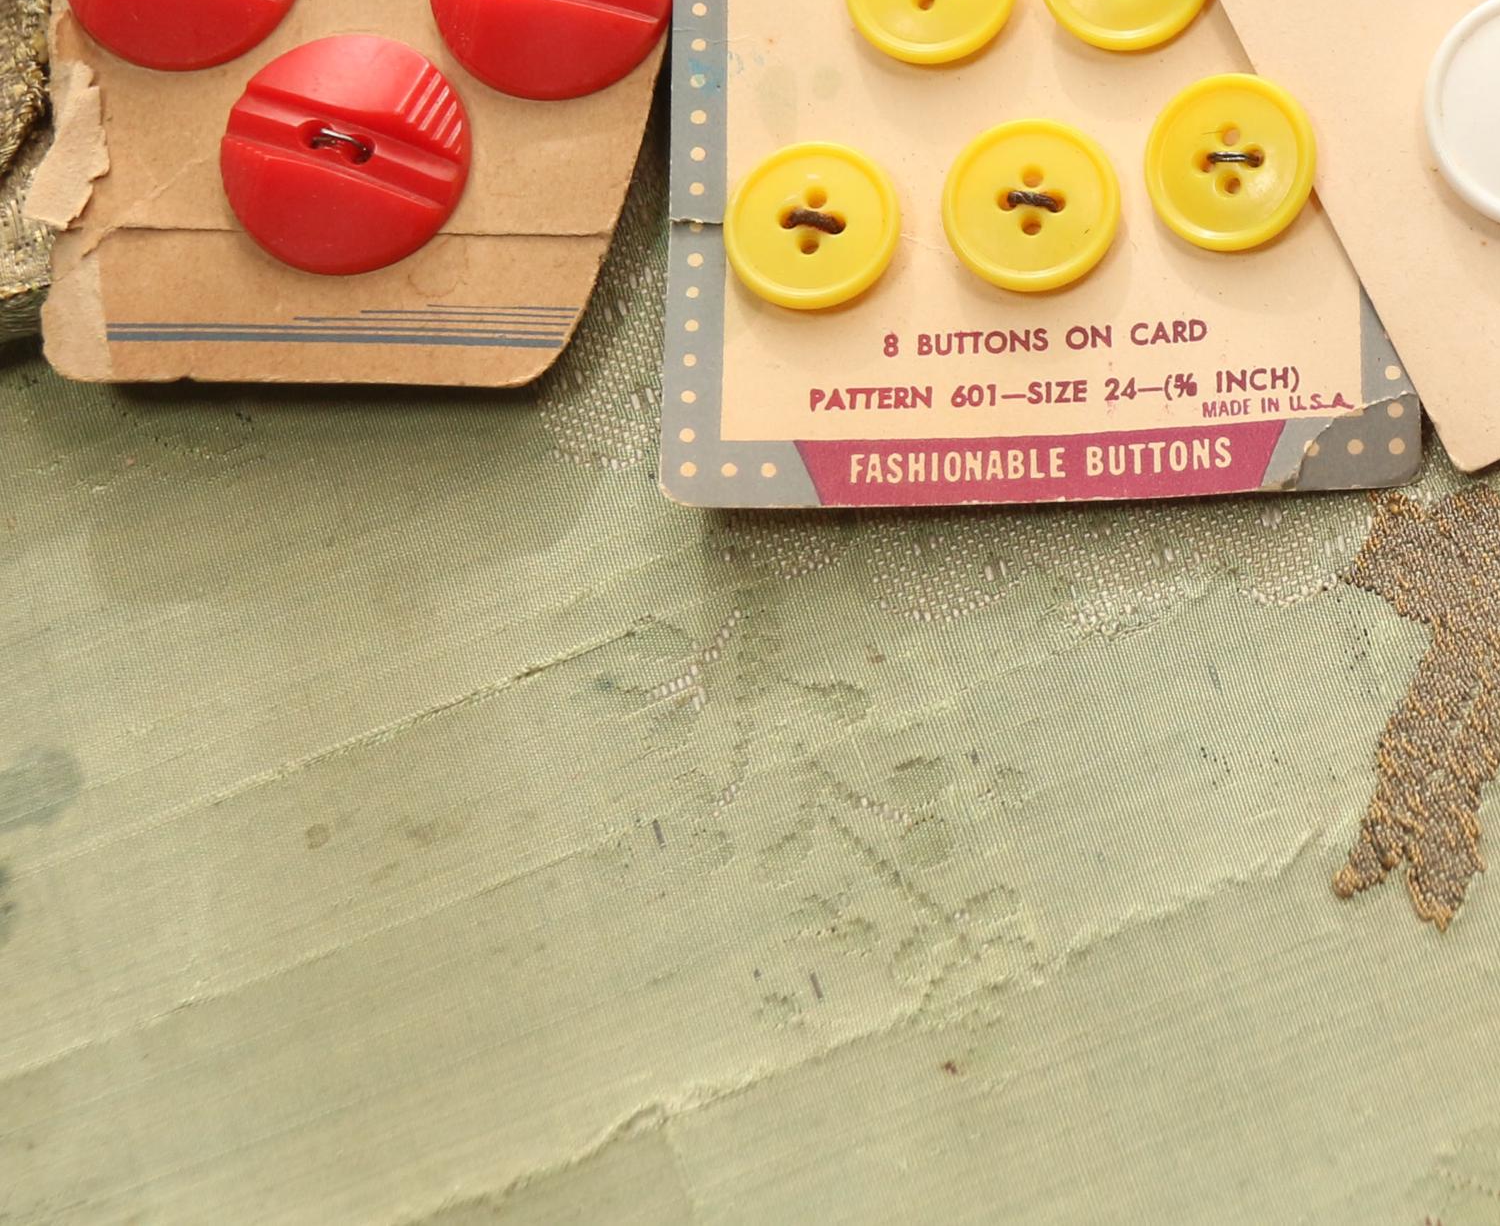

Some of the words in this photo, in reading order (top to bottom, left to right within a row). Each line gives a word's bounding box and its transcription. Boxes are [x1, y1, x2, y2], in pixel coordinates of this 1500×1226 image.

[883, 333, 899, 358] 8
[917, 328, 1049, 356] BUTTONS
[1065, 325, 1112, 351] ON
[1130, 319, 1208, 346] CARD
[809, 386, 933, 412] PATTERN
[1216, 366, 1300, 393] INCH)
[1202, 399, 1251, 418] MADE
[1261, 397, 1280, 414] IN
[850, 447, 1066, 484] FASHIONABLE
[1086, 436, 1232, 477] BUTTONS
